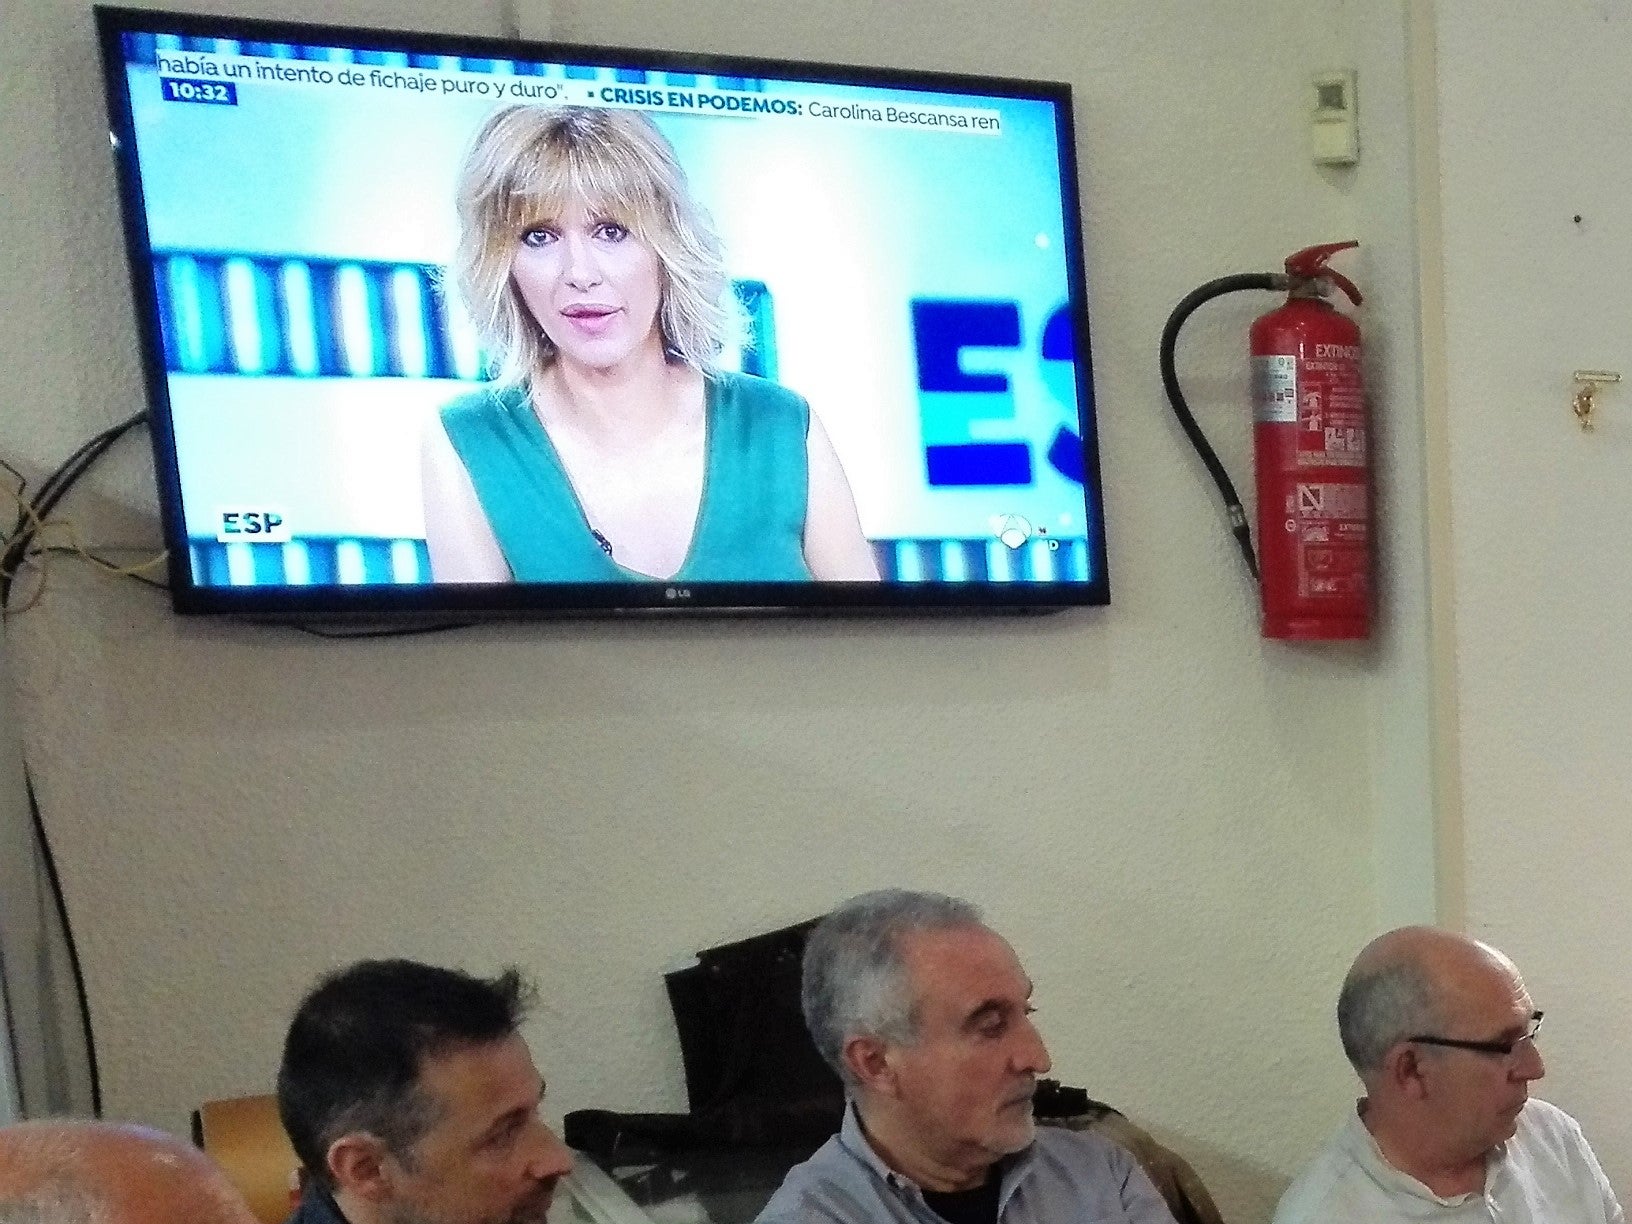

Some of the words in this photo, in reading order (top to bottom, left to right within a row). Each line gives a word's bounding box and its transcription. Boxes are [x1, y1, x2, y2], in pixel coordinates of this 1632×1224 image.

[157, 55, 219, 77] había
[223, 61, 251, 79] un
[256, 62, 334, 84] intento
[337, 68, 366, 87] de
[370, 70, 438, 94] fichaje
[441, 78, 490, 97] puro
[493, 81, 506, 99] y
[169, 81, 229, 101] 10:32
[600, 87, 665, 106] CRISIS
[668, 92, 695, 108] EN
[698, 95, 804, 116] PODEMOS:
[808, 101, 883, 122] Carolina
[887, 107, 968, 129] Bescansa
[972, 117, 1000, 130] ren
[222, 512, 283, 534] ESP
